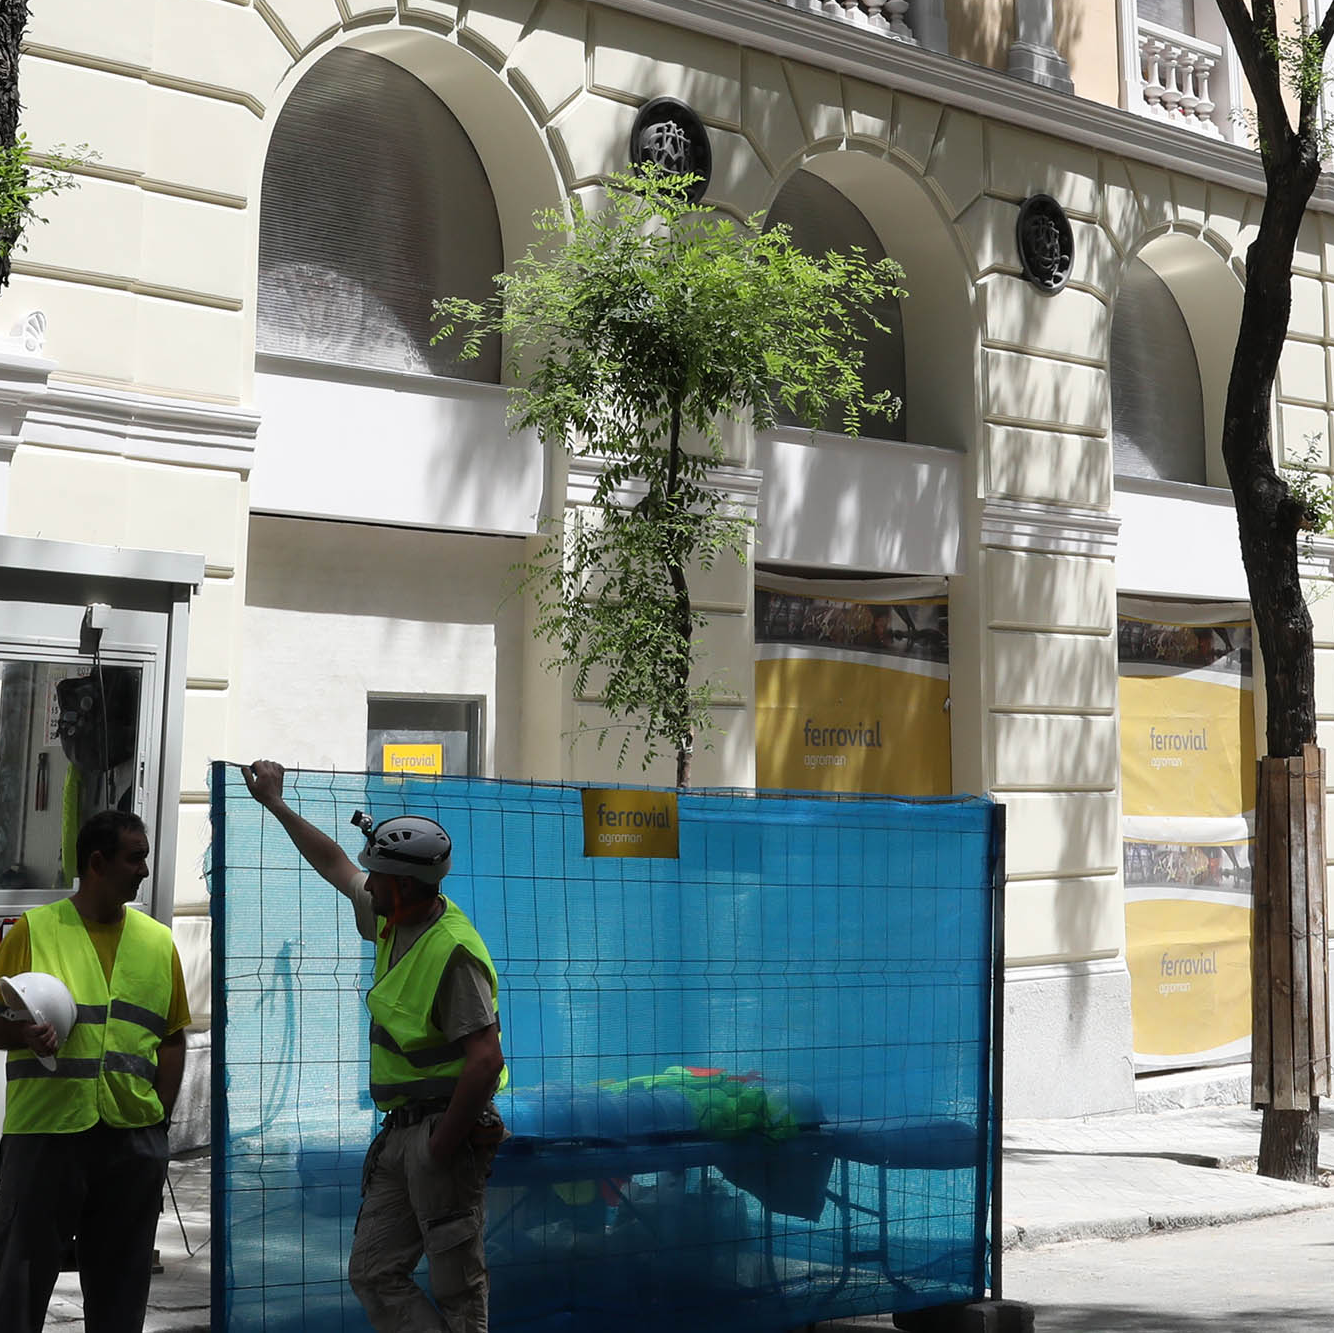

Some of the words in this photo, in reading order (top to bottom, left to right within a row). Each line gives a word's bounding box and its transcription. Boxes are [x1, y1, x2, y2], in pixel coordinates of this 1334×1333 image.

[803, 719, 882, 748] ferrovial
[1150, 726, 1207, 751] ferrovial
[391, 753, 435, 766] ferrovial
[803, 754, 846, 769] agroman
[596, 802, 670, 829] ferrovial
[598, 833, 643, 846] agroman
[1161, 951, 1217, 977] ferrovial
